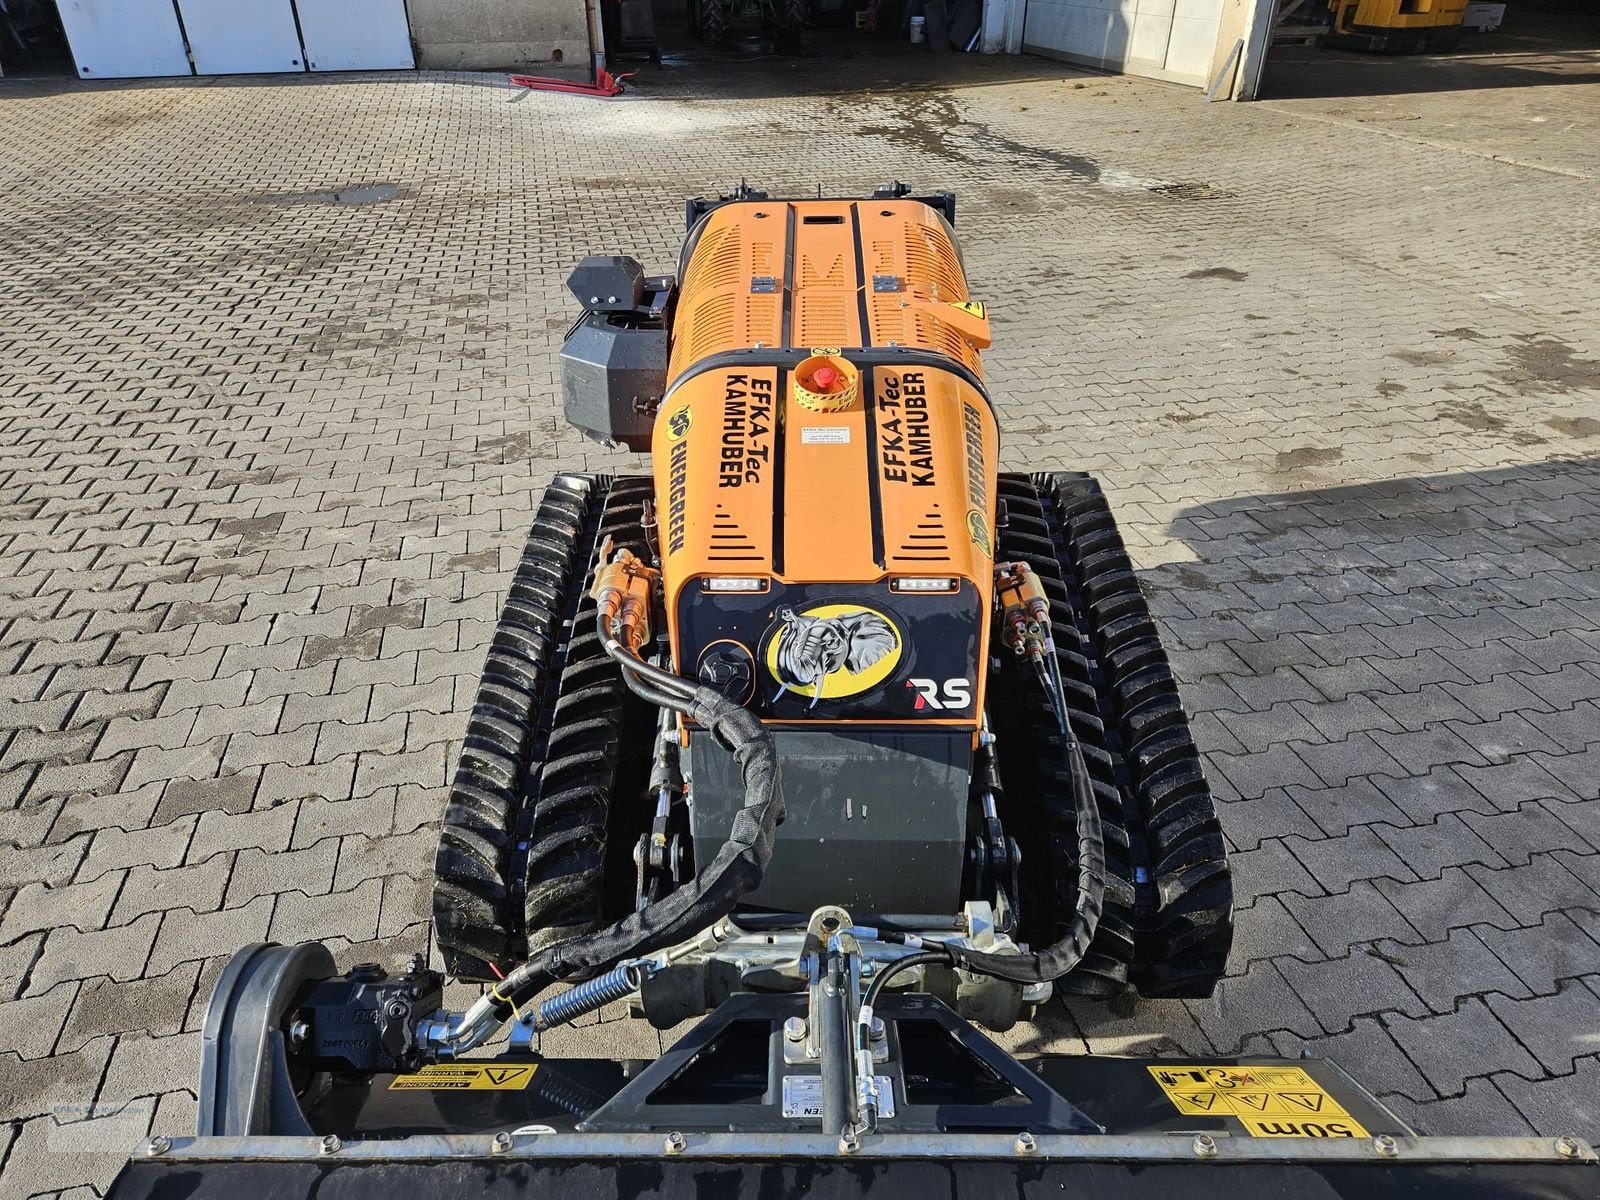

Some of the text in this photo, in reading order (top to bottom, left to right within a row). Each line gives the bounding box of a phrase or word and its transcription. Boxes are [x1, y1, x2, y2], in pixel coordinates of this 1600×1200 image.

[719, 374, 748, 488] KAMHUBER
[745, 378, 772, 484] EFKA-Tec
[880, 376, 908, 484] EFKA-Tec
[903, 372, 936, 487] KAMHUBER
[669, 439, 687, 557] ENERGREEN
[905, 678, 971, 710] RS
[1256, 1122, 1354, 1138] 50m
